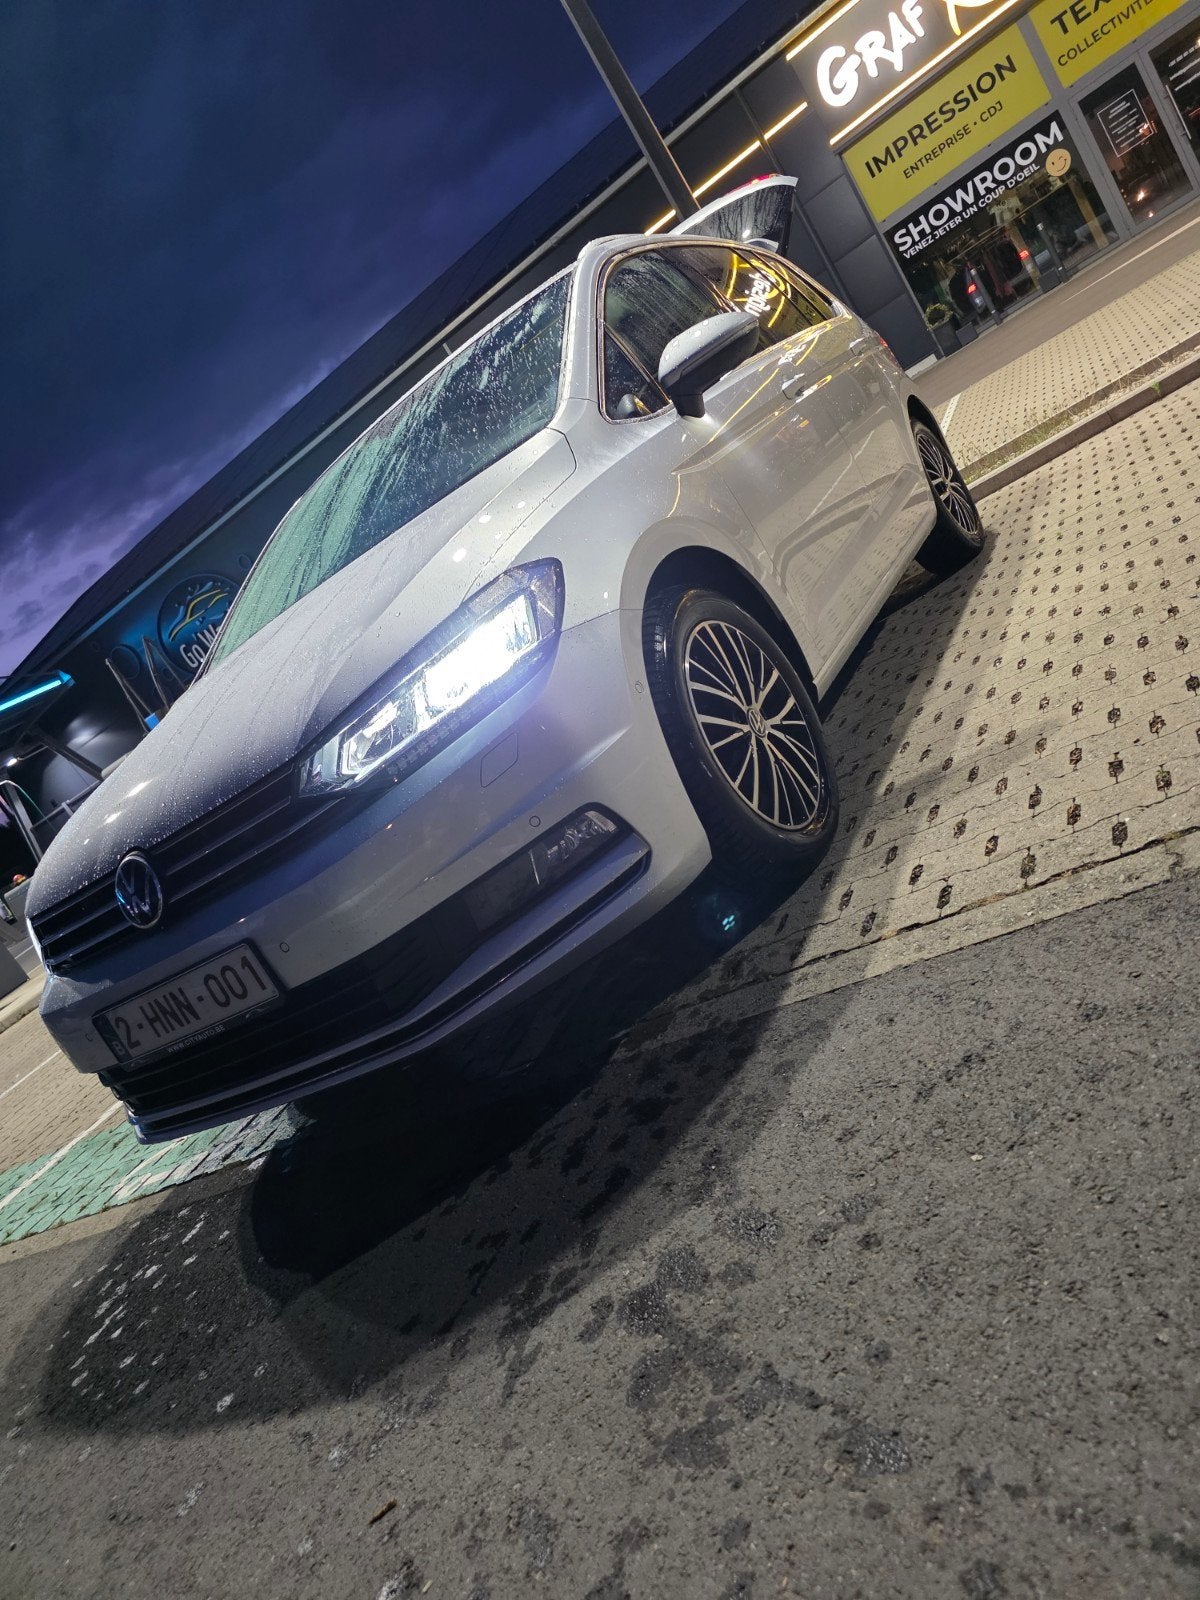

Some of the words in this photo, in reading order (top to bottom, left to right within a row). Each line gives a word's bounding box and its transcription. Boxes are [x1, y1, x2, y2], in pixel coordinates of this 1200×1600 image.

[817, 0, 925, 107] GRAF
[864, 54, 1018, 179] IMPRESSION
[903, 123, 972, 179] ENTREPRISE
[979, 100, 1004, 123] CDJ
[893, 120, 1064, 252] SHOWROOM
[902, 235, 934, 260] VENEZ
[934, 215, 963, 240] JETER
[963, 204, 979, 219] UN
[978, 185, 1006, 209] COUP
[1007, 162, 1041, 189] D'OEIL
[114, 955, 267, 1050] 2-HNN-001
